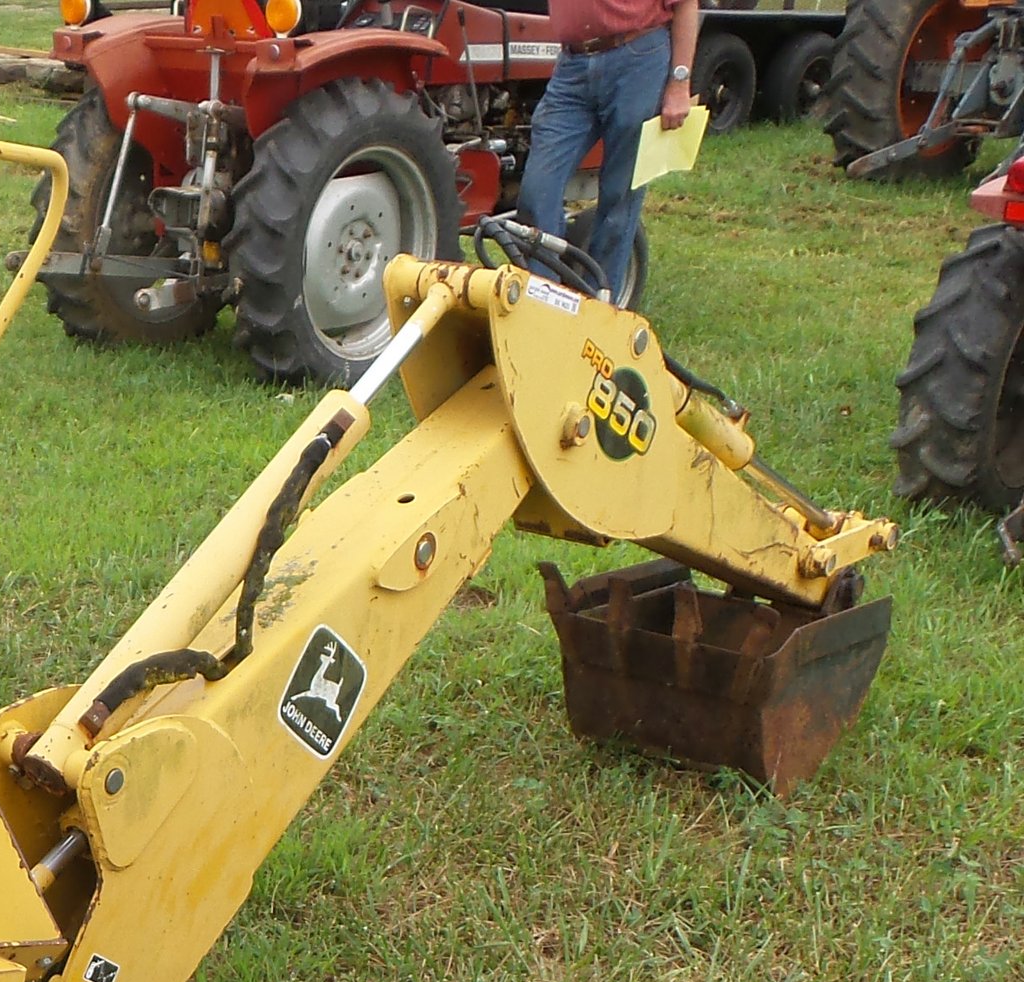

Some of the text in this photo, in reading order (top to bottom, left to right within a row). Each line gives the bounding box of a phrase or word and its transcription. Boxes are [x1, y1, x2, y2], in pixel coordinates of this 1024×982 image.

[581, 337, 614, 380] PRO
[586, 371, 657, 456] 850
[282, 701, 333, 752] JOHN DEERE
